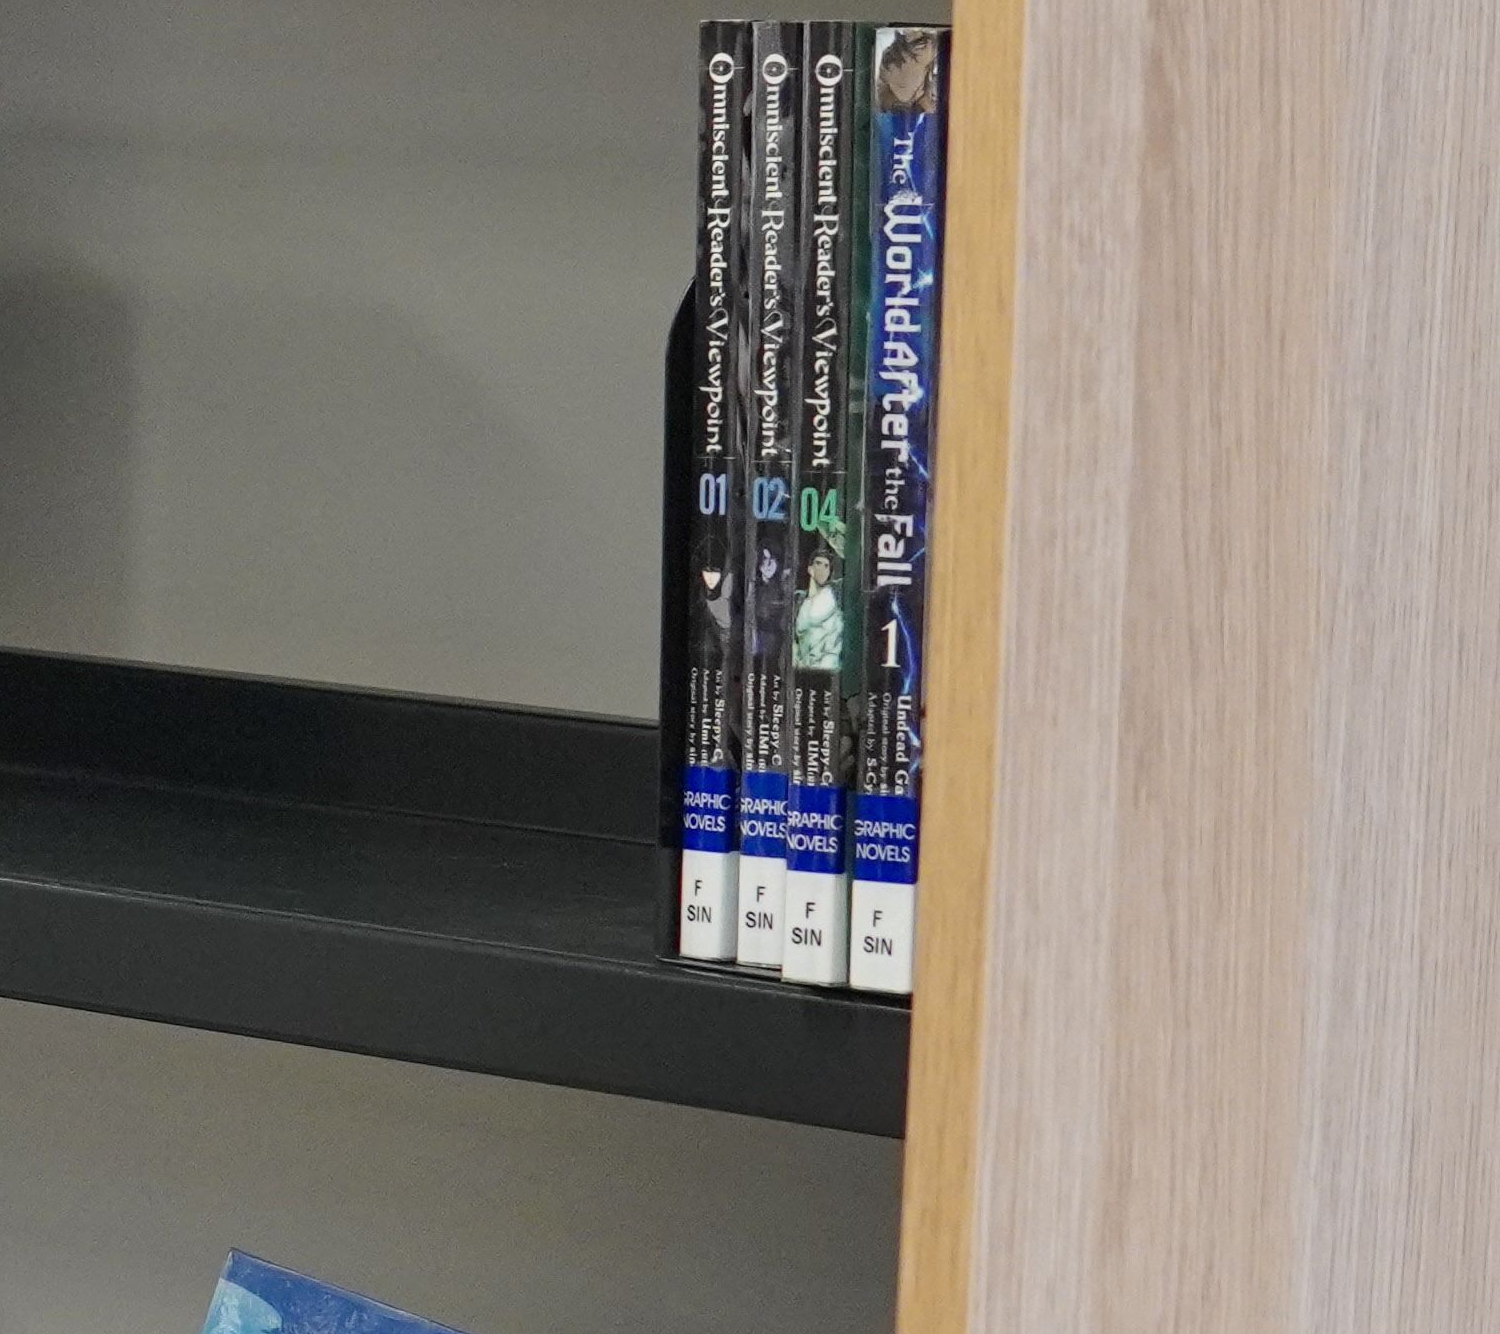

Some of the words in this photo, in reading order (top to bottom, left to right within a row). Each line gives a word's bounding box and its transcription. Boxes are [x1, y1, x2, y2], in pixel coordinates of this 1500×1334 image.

[708, 52, 735, 208] Omniscient
[892, 131, 914, 185] The
[707, 207, 731, 309] Reader's
[883, 198, 923, 333] World
[699, 308, 730, 454] Viewpoint
[881, 338, 923, 467] After
[699, 473, 728, 517] 01
[883, 467, 904, 510] the
[876, 514, 914, 589] Fall
[881, 619, 901, 669] 1
